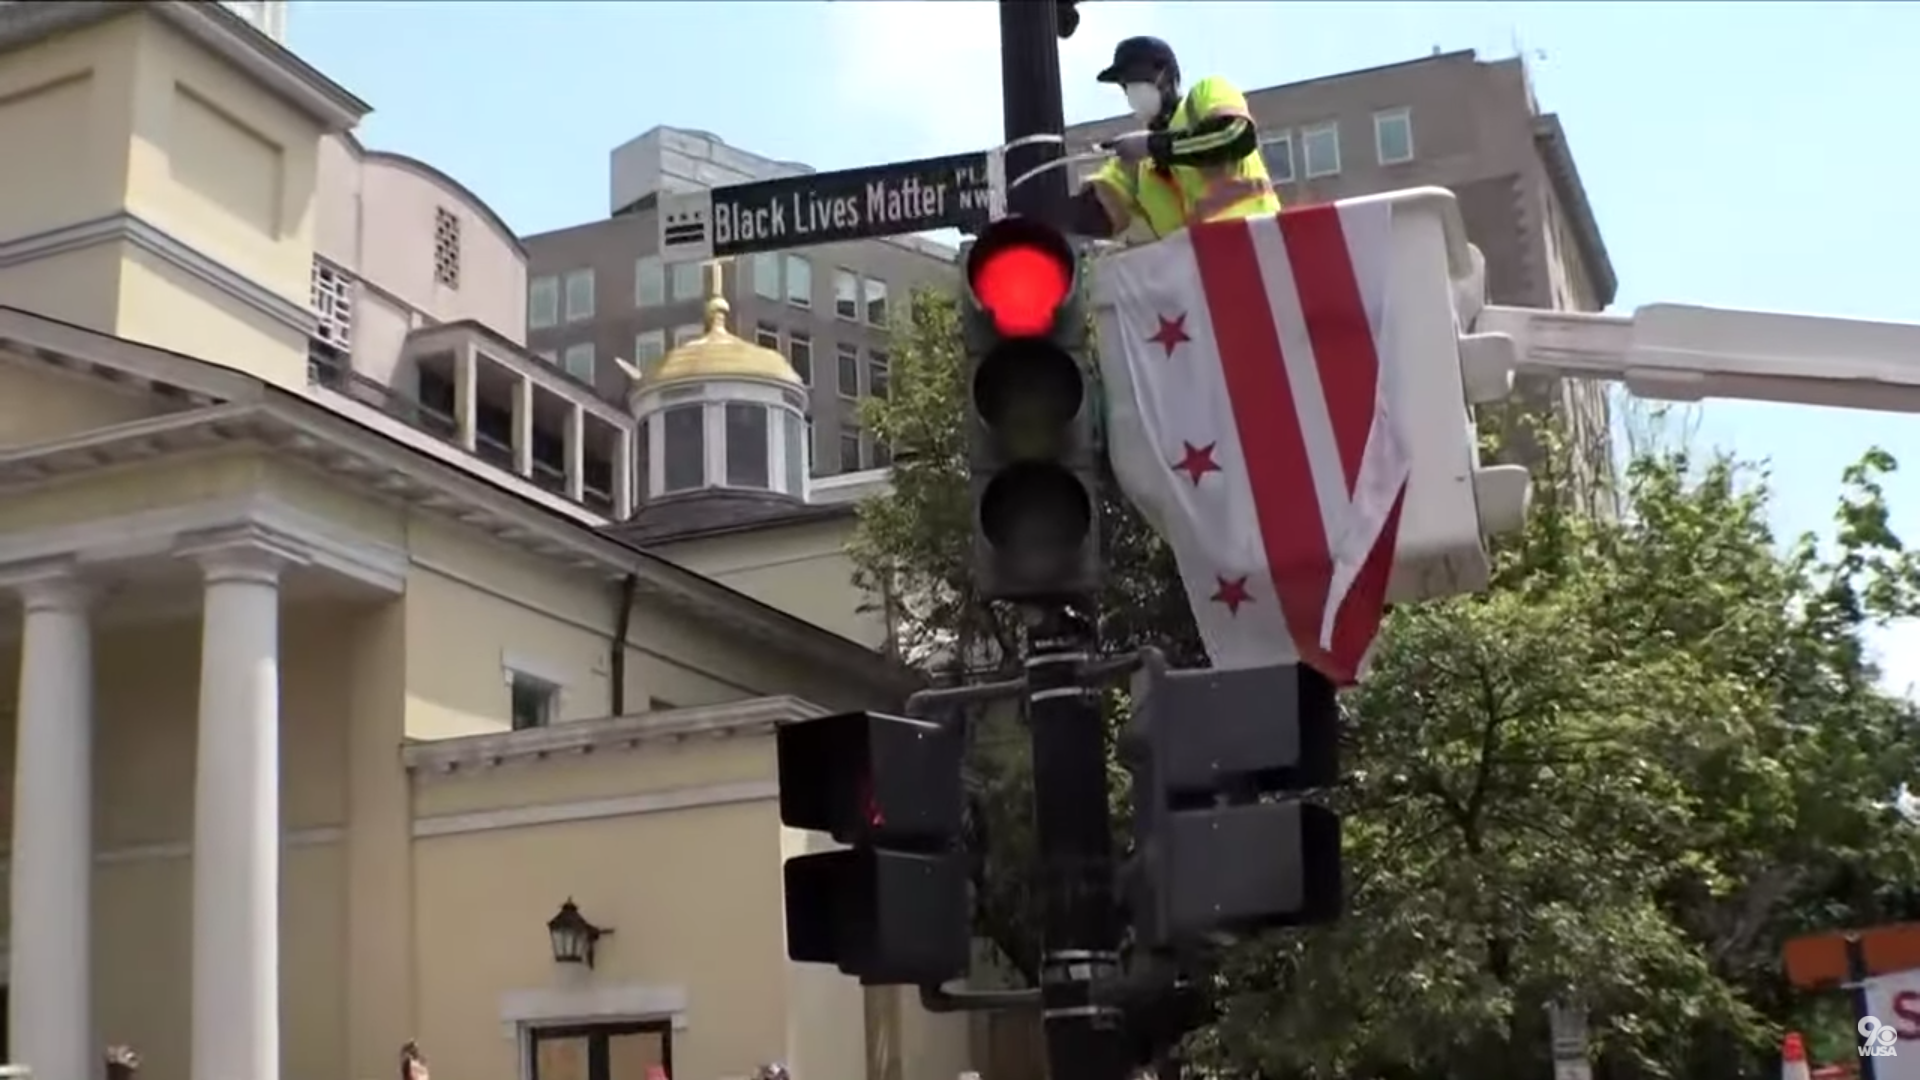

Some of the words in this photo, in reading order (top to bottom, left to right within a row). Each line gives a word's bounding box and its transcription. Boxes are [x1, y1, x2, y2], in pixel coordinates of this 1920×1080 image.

[714, 196, 786, 243] Black
[793, 190, 860, 233] Lives
[866, 177, 947, 223] Matter
[959, 188, 991, 209] NW
